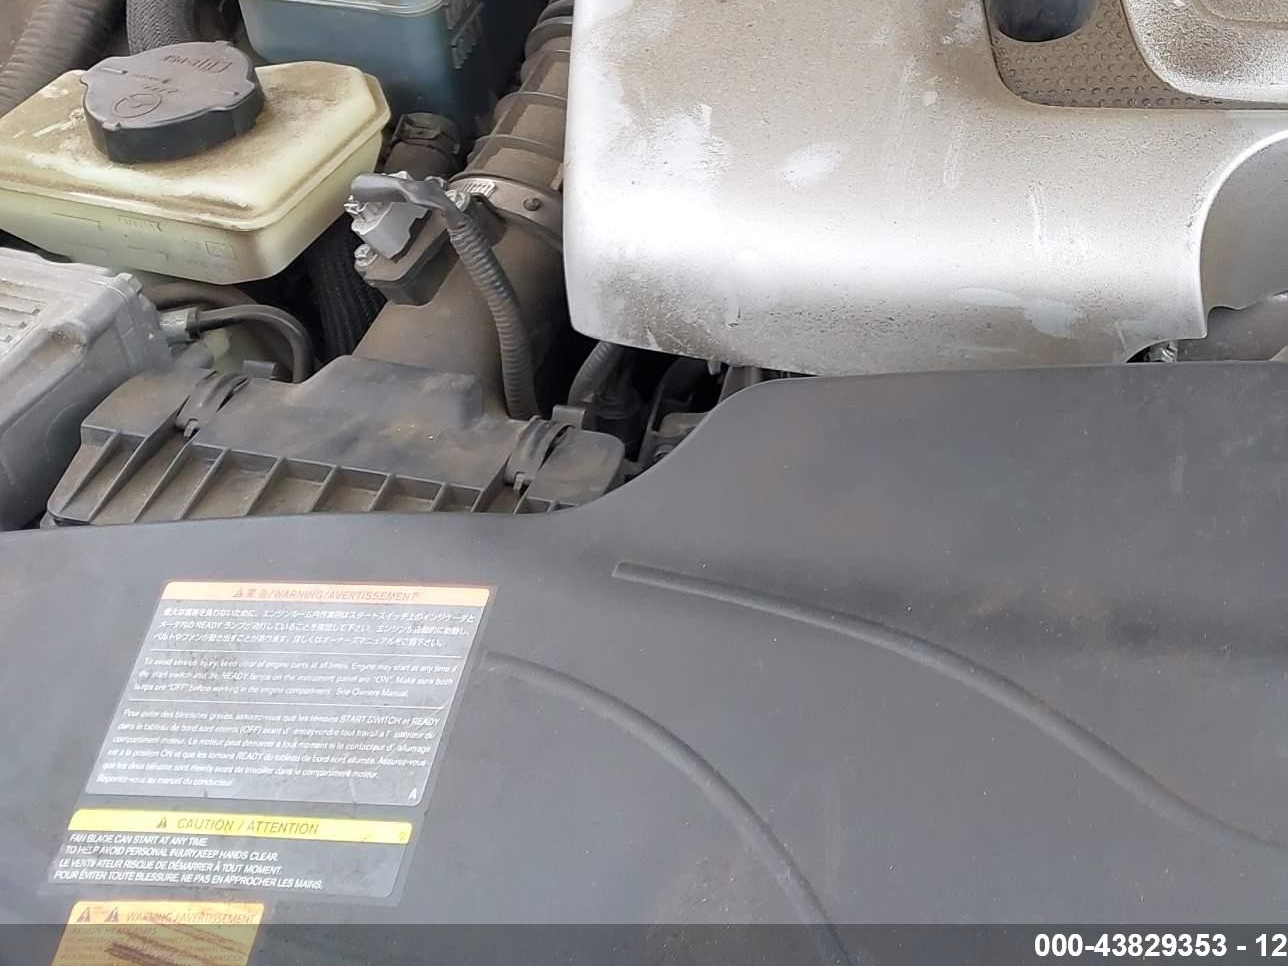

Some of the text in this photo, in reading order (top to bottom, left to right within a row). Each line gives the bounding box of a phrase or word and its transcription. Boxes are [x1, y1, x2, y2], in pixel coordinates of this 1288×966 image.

[339, 715, 367, 723] START
[411, 717, 440, 725] READY
[237, 752, 262, 760] READY
[408, 787, 418, 800] A
[177, 817, 235, 832] CAUTION
[247, 820, 319, 835] ATTENTION
[69, 834, 87, 843] FAN
[87, 834, 113, 844] BLADE
[114, 835, 132, 844] CAN
[133, 836, 158, 844] START
[159, 836, 170, 844] AT
[170, 837, 188, 845] ANY
[65, 845, 78, 854] TO
[79, 846, 100, 855] HELP
[100, 846, 125, 856] AVOID
[125, 847, 168, 857] PERSONAL
[219, 851, 248, 860] HANDS
[59, 859, 71, 868] LE
[123, 860, 155, 870] RISQUE
[155, 862, 167, 870] DE
[221, 864, 243, 873] TOUT
[54, 871, 78, 880] POUR
[108, 872, 135, 881] TOUTE
[180, 874, 193, 883] NE
[193, 875, 210, 883] PAS
[224, 876, 277, 887] APPROCHER
[277, 879, 293, 888] LES
